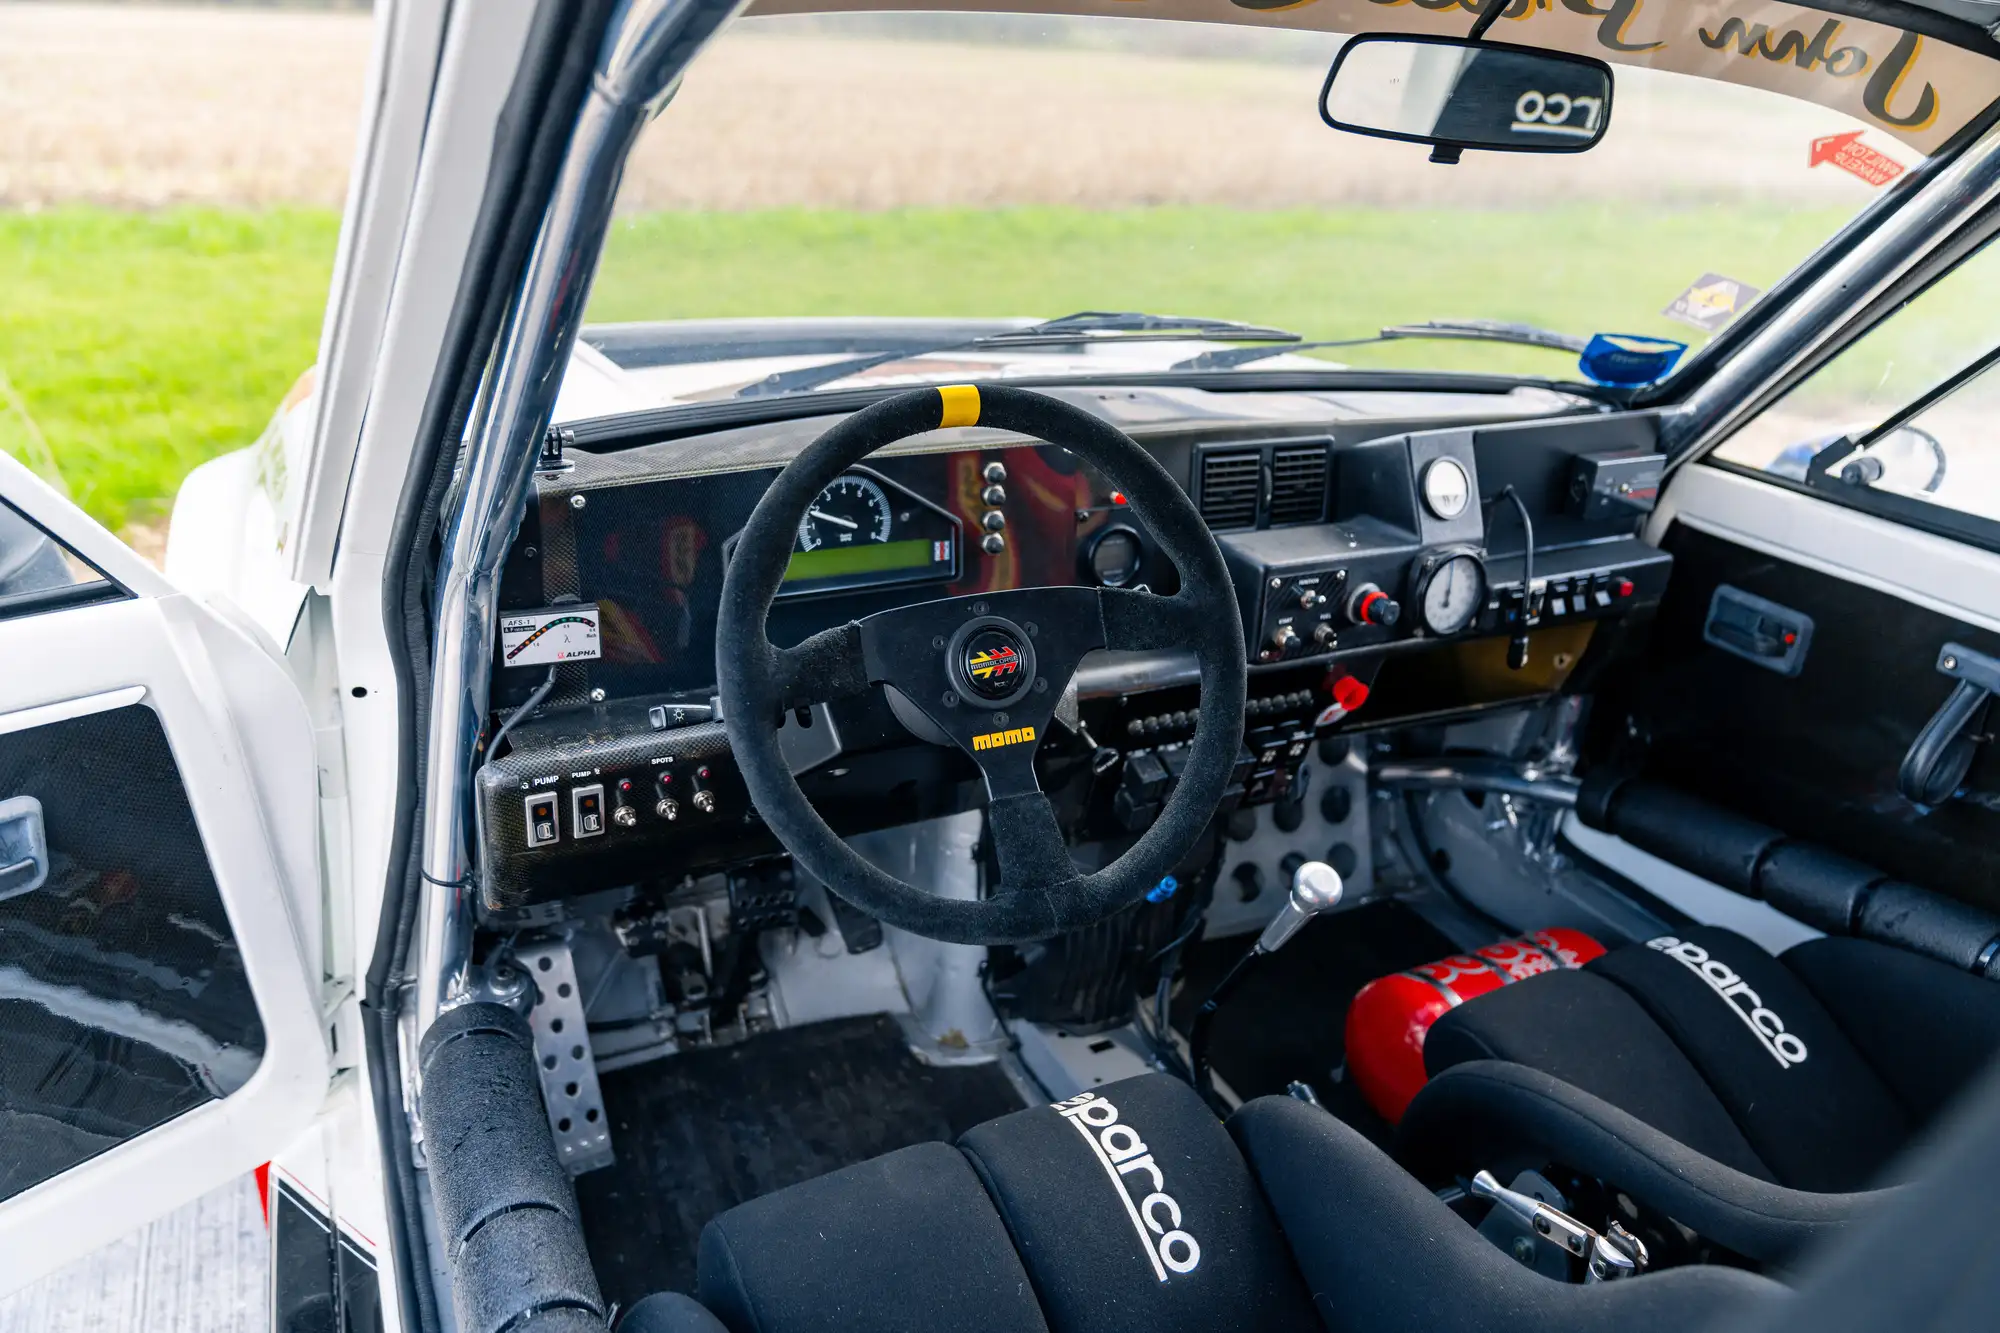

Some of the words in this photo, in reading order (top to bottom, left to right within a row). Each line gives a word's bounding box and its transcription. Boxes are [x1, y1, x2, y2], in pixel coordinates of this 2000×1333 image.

[566, 649, 596, 658] ALPHA
[651, 756, 674, 765] SPOTS
[571, 770, 591, 778] PUMP
[534, 775, 560, 786] PUMP
